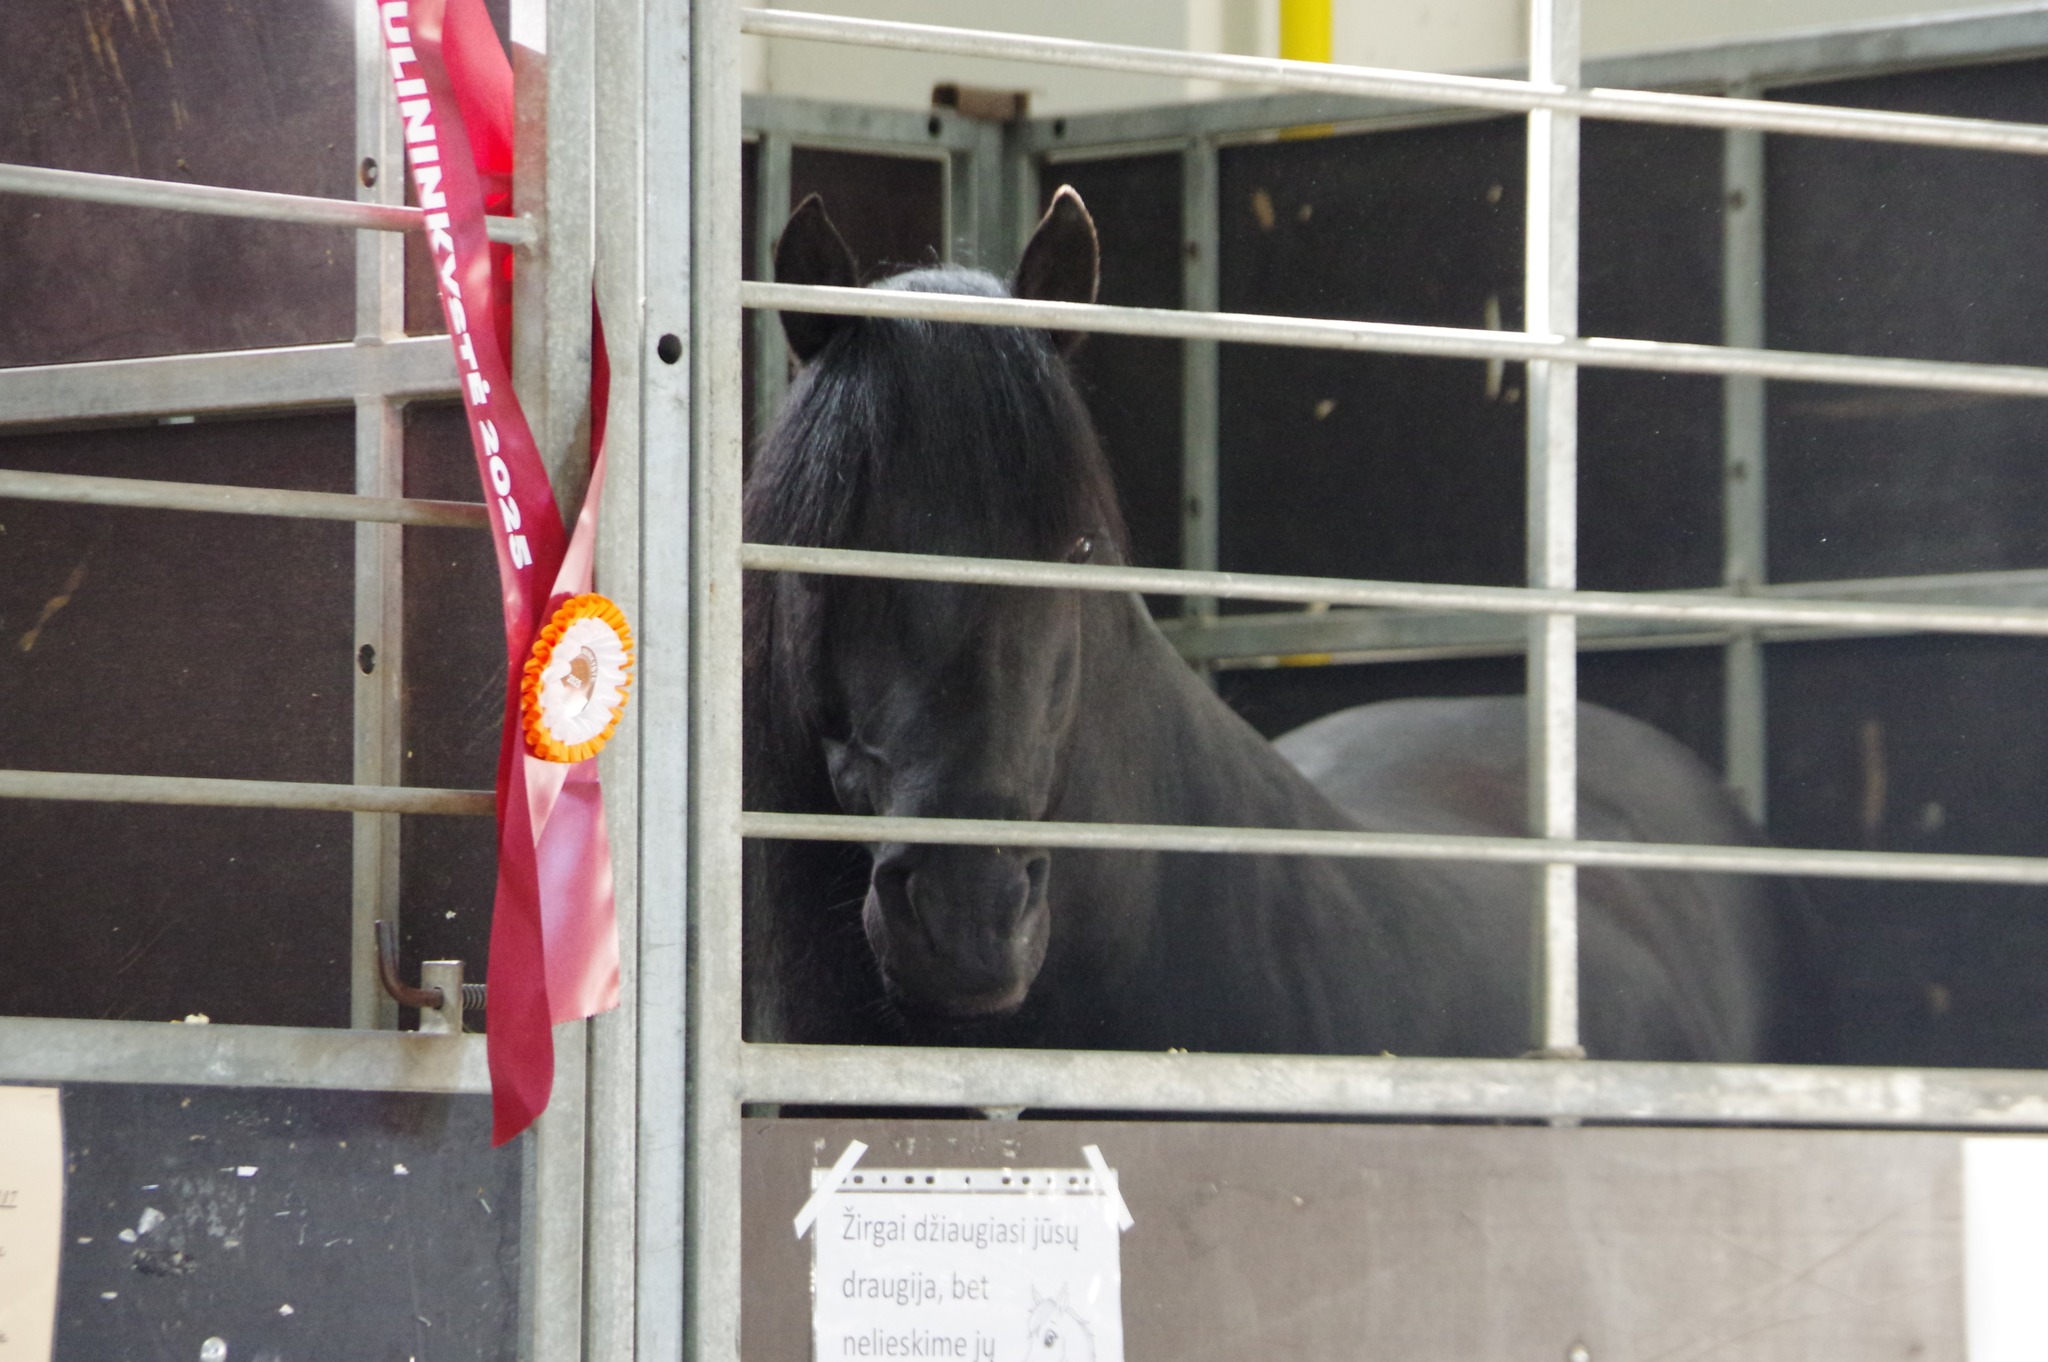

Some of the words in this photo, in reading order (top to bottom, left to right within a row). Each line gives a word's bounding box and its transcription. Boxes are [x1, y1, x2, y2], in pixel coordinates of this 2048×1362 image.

[478, 419, 533, 570] 2025
[842, 1206, 906, 1248] Žirgai
[914, 1213, 1027, 1250] džiaugiasi
[1031, 1215, 1079, 1251] jūsų
[842, 1270, 944, 1306] draugija,
[952, 1271, 990, 1301] bet
[843, 1327, 967, 1358] nelieskime
[973, 1330, 996, 1362] jų
